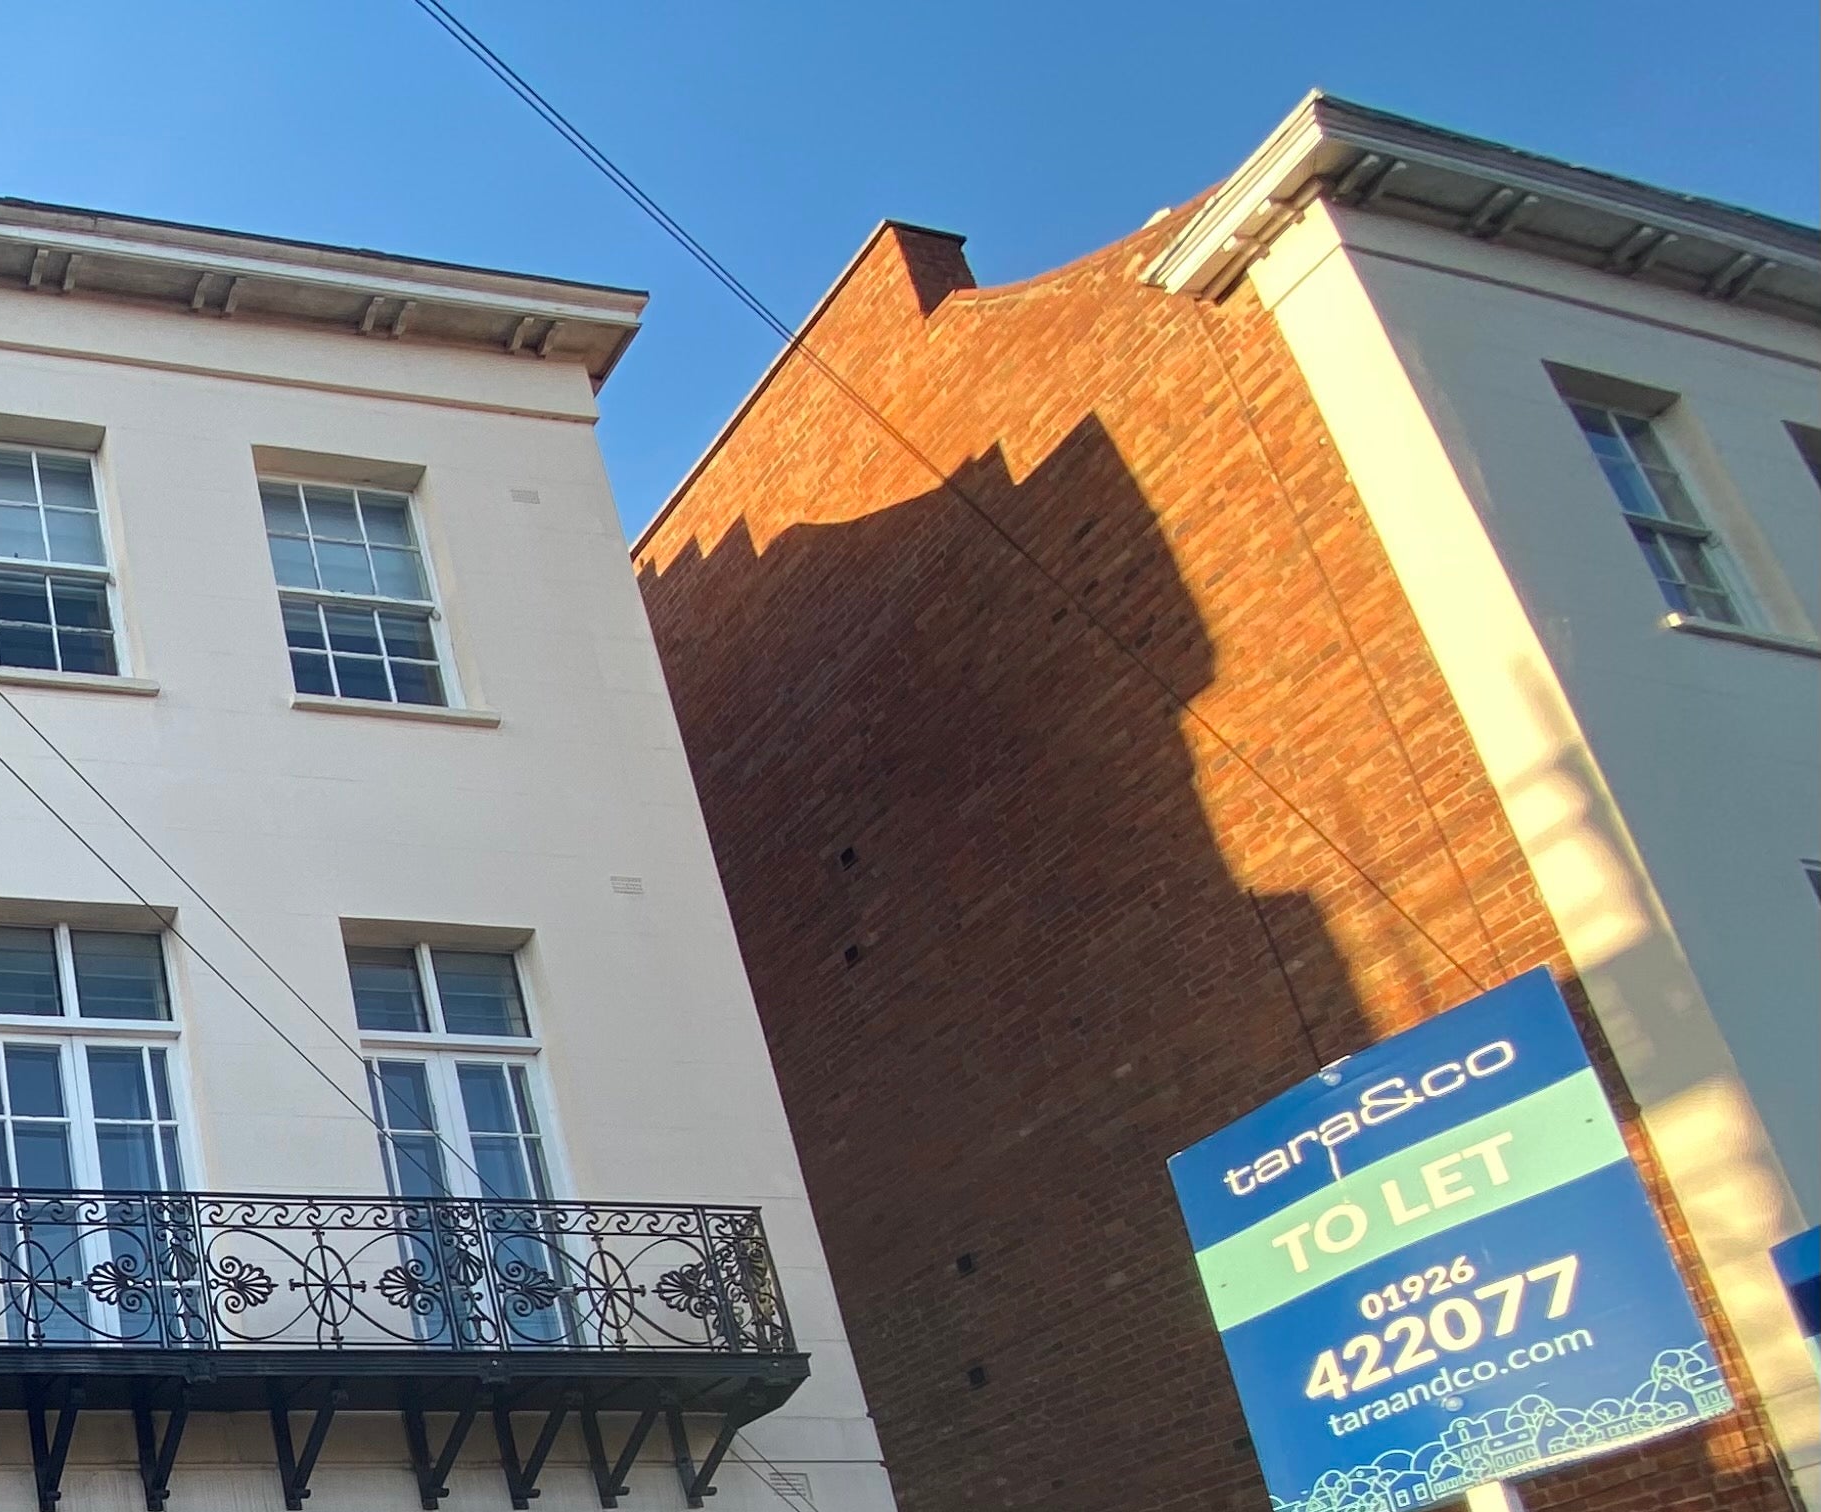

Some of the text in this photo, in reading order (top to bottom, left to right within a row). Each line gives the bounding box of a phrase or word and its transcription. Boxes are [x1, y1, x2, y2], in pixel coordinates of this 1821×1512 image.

[1223, 1040, 1516, 1196] tara&co
[1271, 1132, 1513, 1273] TO LET
[1305, 1255, 1578, 1400] 422077
[1360, 1256, 1475, 1321] 01926
[1329, 1328, 1593, 1437] taraandco.com
